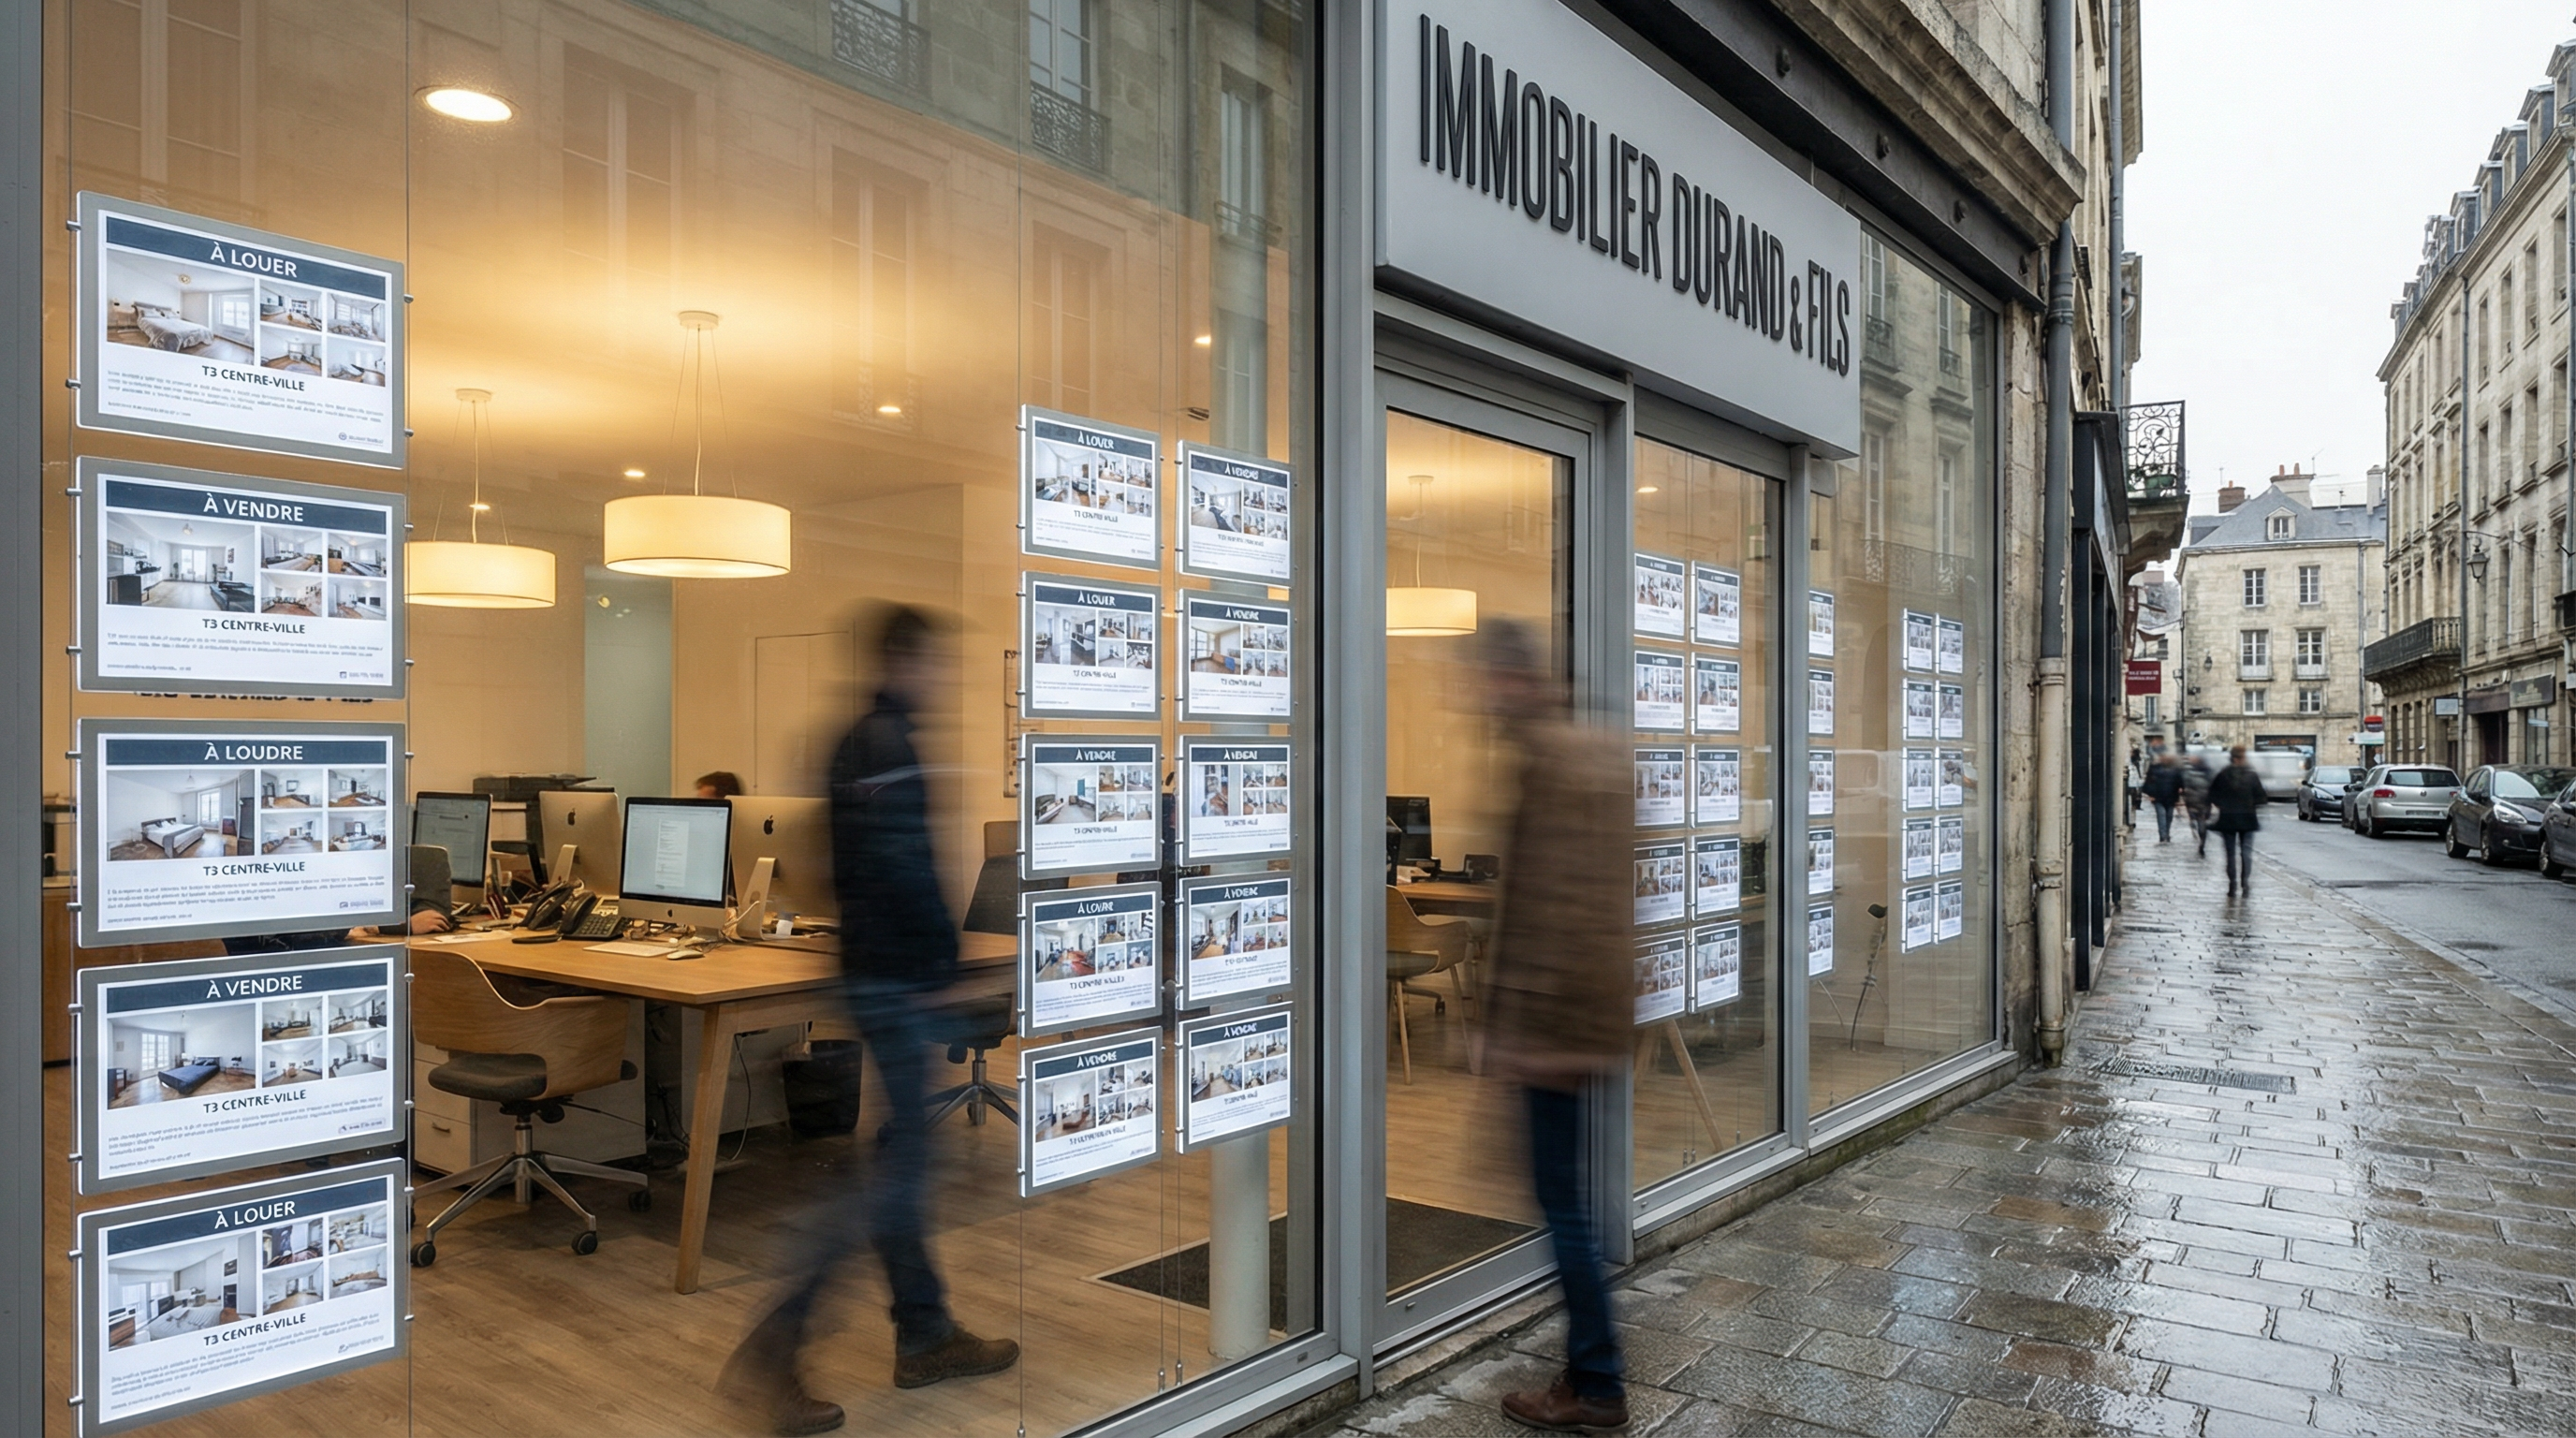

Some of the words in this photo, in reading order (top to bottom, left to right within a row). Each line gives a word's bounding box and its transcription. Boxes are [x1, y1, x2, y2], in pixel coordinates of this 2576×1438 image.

[1420, 13, 1661, 280] IMMOBILIER
[1673, 172, 1784, 341] DURAND
[1790, 275, 1803, 351] &
[1808, 258, 1850, 377] FILS
[210, 242, 226, 263] À
[231, 249, 298, 278] LOUER
[201, 365, 218, 377] T3
[221, 369, 305, 391] CENTRE-VILLE
[203, 492, 218, 513] À
[223, 498, 304, 522] VENDRE
[201, 618, 218, 629] T3
[221, 619, 306, 635] CENTRE-VILLE
[204, 742, 220, 761] À
[226, 745, 303, 761] LOUDRE
[203, 865, 218, 876] T3
[222, 861, 305, 876] CENTRE-VILLE
[206, 980, 221, 999] À
[225, 976, 302, 996] VENDRE
[203, 1102, 218, 1114] T3
[222, 1089, 307, 1113] CENTRE-VILLE
[214, 1211, 229, 1229] À
[234, 1200, 296, 1225] LOUER
[203, 1334, 219, 1346] T3
[222, 1313, 307, 1343] CENTRE-VILLE
